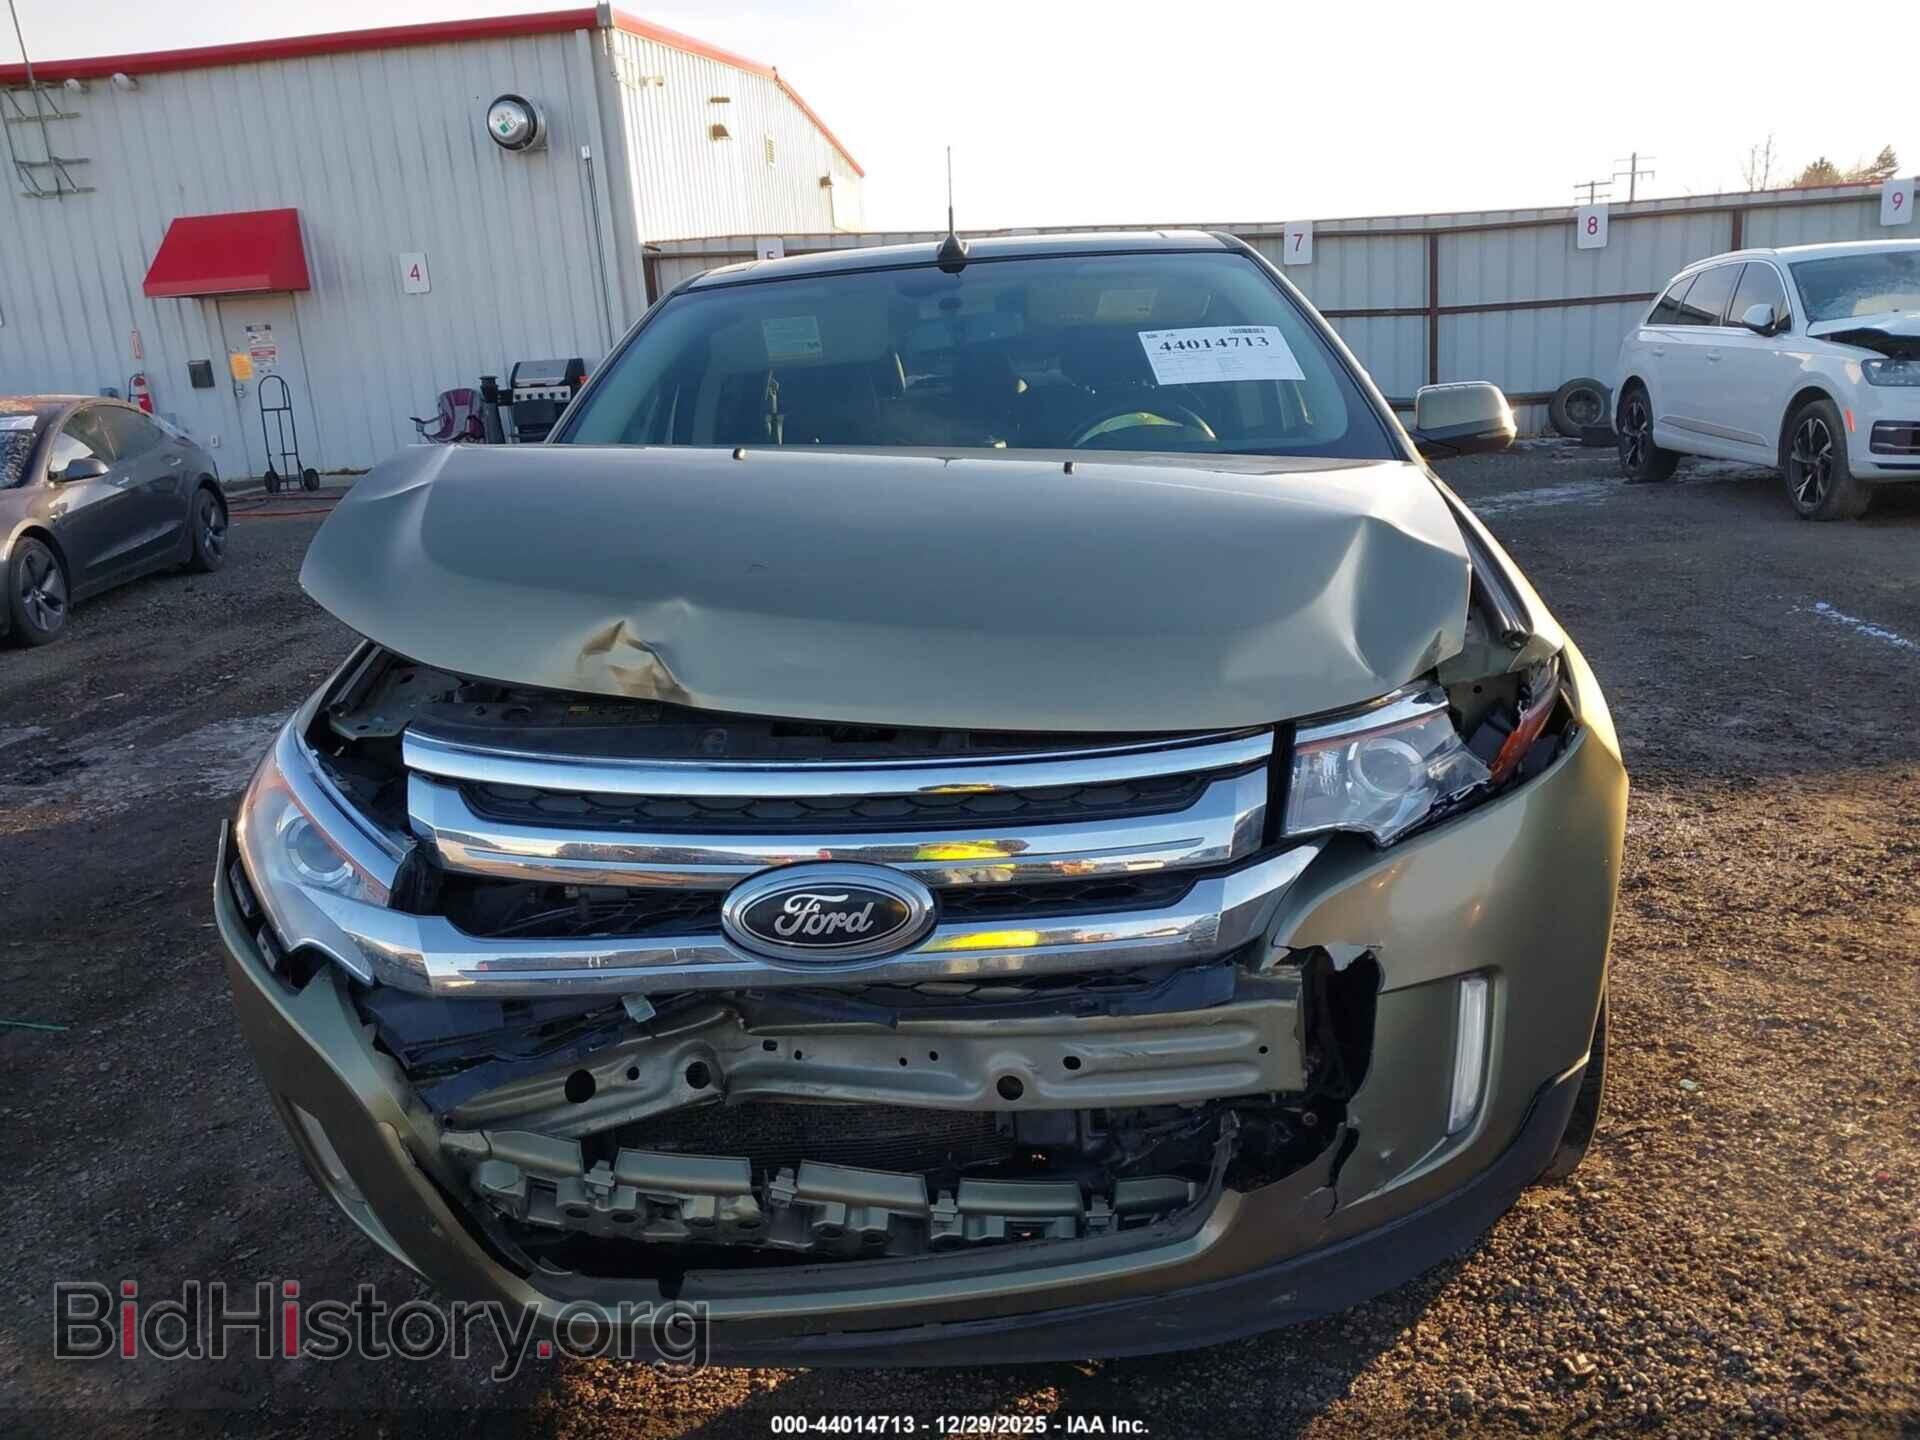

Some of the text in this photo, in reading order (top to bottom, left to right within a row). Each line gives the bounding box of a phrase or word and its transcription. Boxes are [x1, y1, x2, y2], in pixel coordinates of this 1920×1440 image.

[1892, 191, 1904, 211] 9
[1587, 215, 1598, 236] 8
[1292, 232, 1304, 252] 7
[410, 263, 420, 281] 4
[1159, 336, 1270, 351] 44014713
[774, 893, 874, 936] Ford
